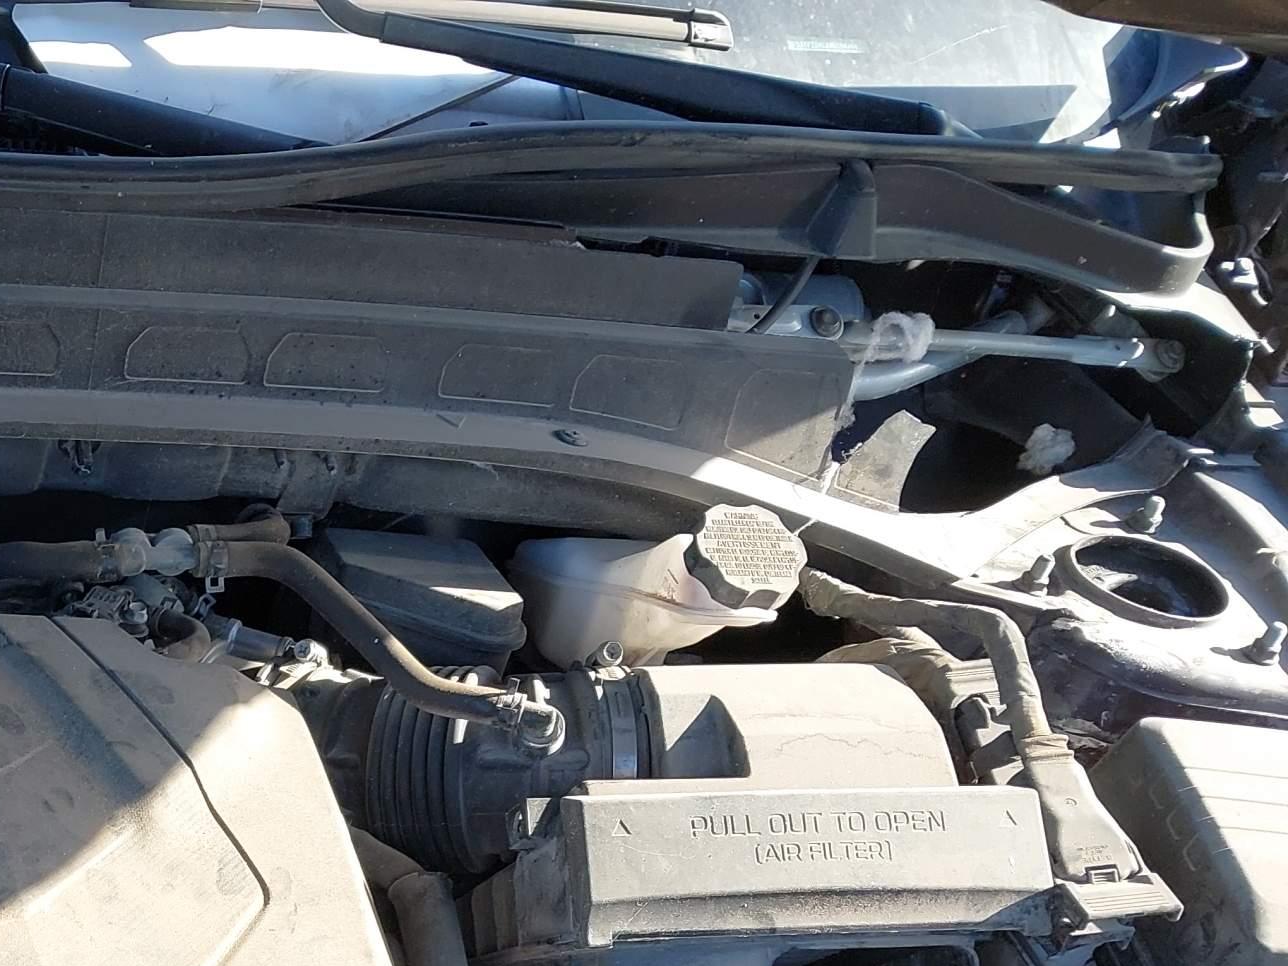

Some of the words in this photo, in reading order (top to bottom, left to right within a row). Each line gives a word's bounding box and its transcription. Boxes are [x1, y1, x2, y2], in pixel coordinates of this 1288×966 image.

[690, 814, 761, 838] PULL
[769, 812, 822, 835] OUT
[829, 811, 866, 833] TO
[874, 809, 947, 833] OPEN
[754, 842, 803, 865] (AIR
[808, 839, 894, 863] FILTER)
